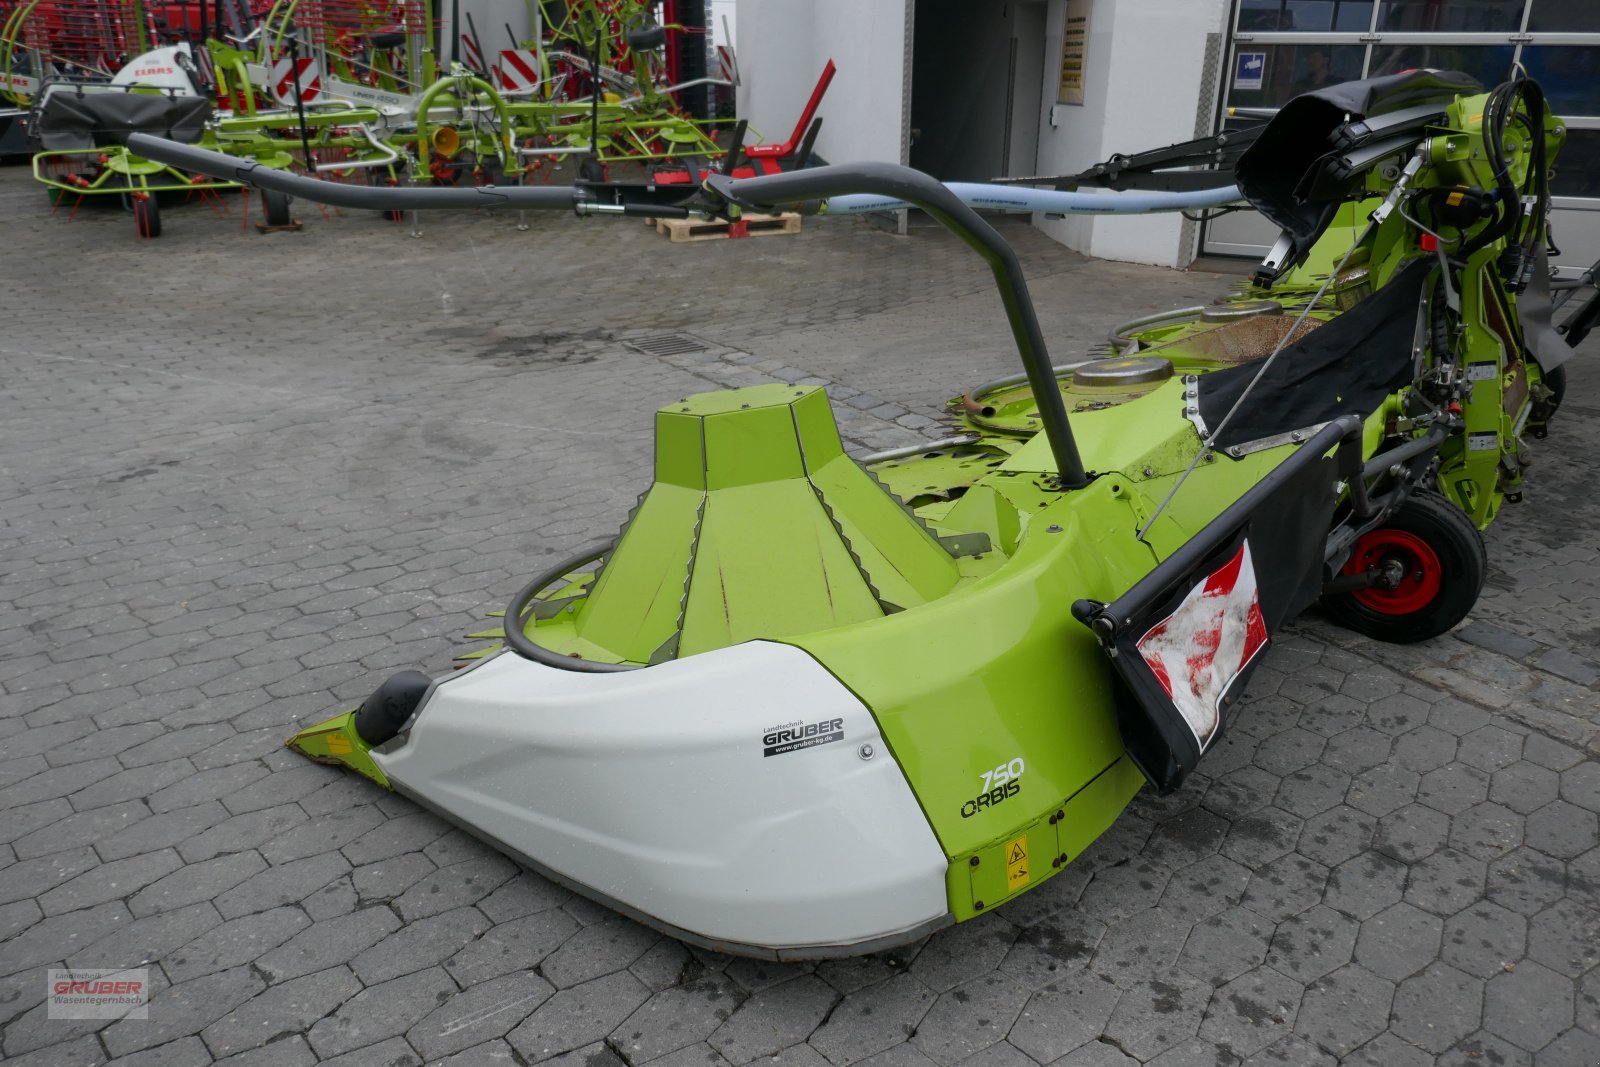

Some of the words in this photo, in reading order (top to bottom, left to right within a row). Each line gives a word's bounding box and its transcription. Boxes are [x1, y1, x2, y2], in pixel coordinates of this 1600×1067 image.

[134, 67, 174, 77] CLAAS
[763, 719, 804, 734] Landtechnik
[763, 717, 844, 746] GRUBER
[775, 735, 833, 753] www.gruber-kg.de
[979, 757, 1025, 794] 750
[960, 778, 1021, 818] ORBIS
